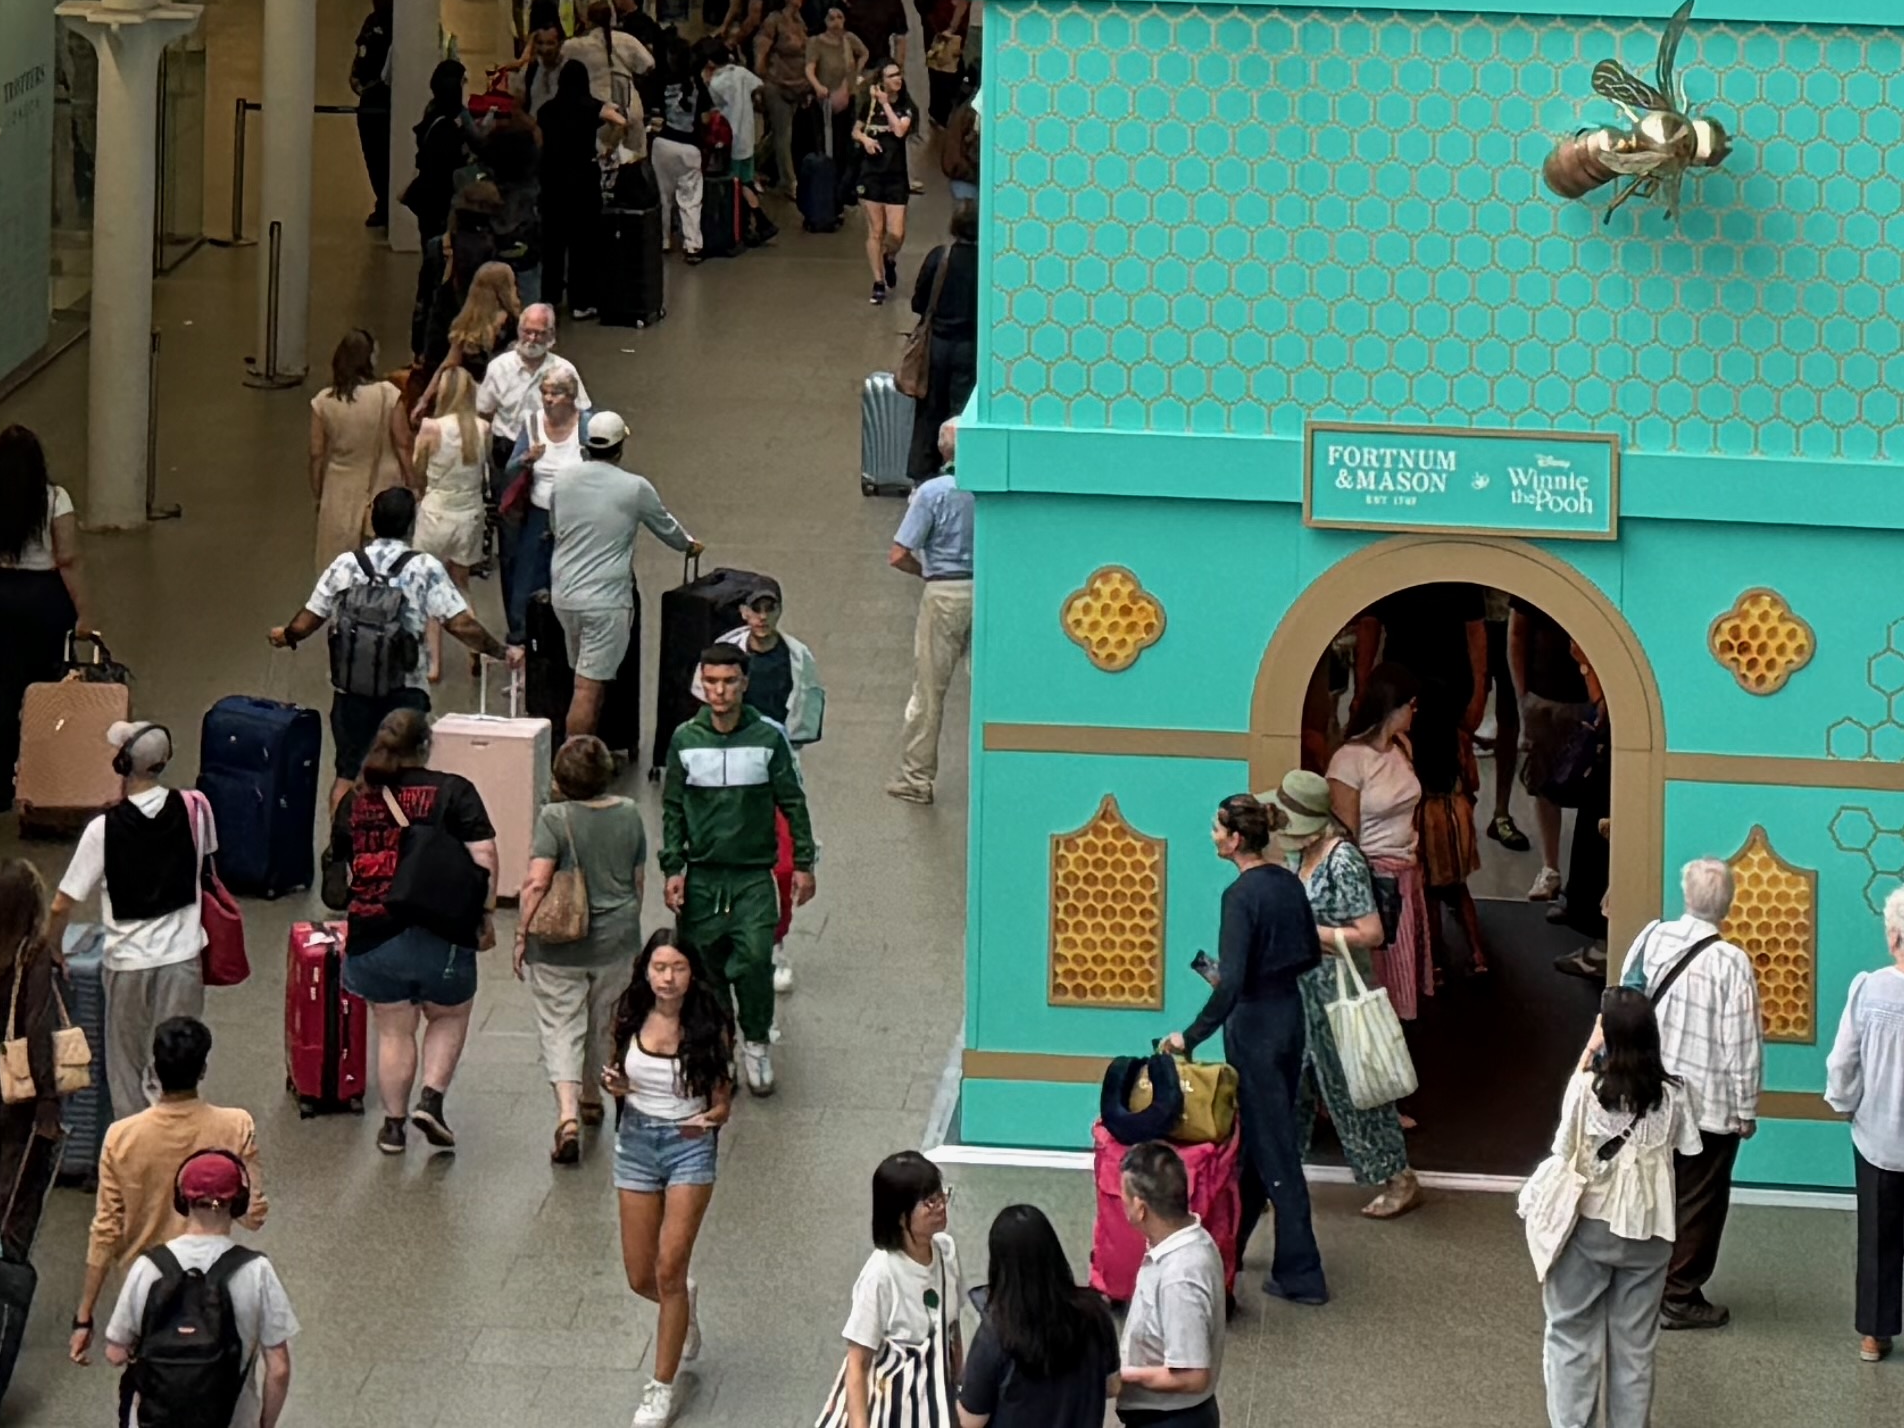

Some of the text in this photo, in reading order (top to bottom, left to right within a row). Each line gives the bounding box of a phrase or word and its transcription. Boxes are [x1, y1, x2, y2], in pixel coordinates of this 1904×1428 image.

[1328, 446, 1456, 471] FORTNUM
[1507, 467, 1589, 490] Winnie
[1511, 488, 1593, 514] the Pooh
